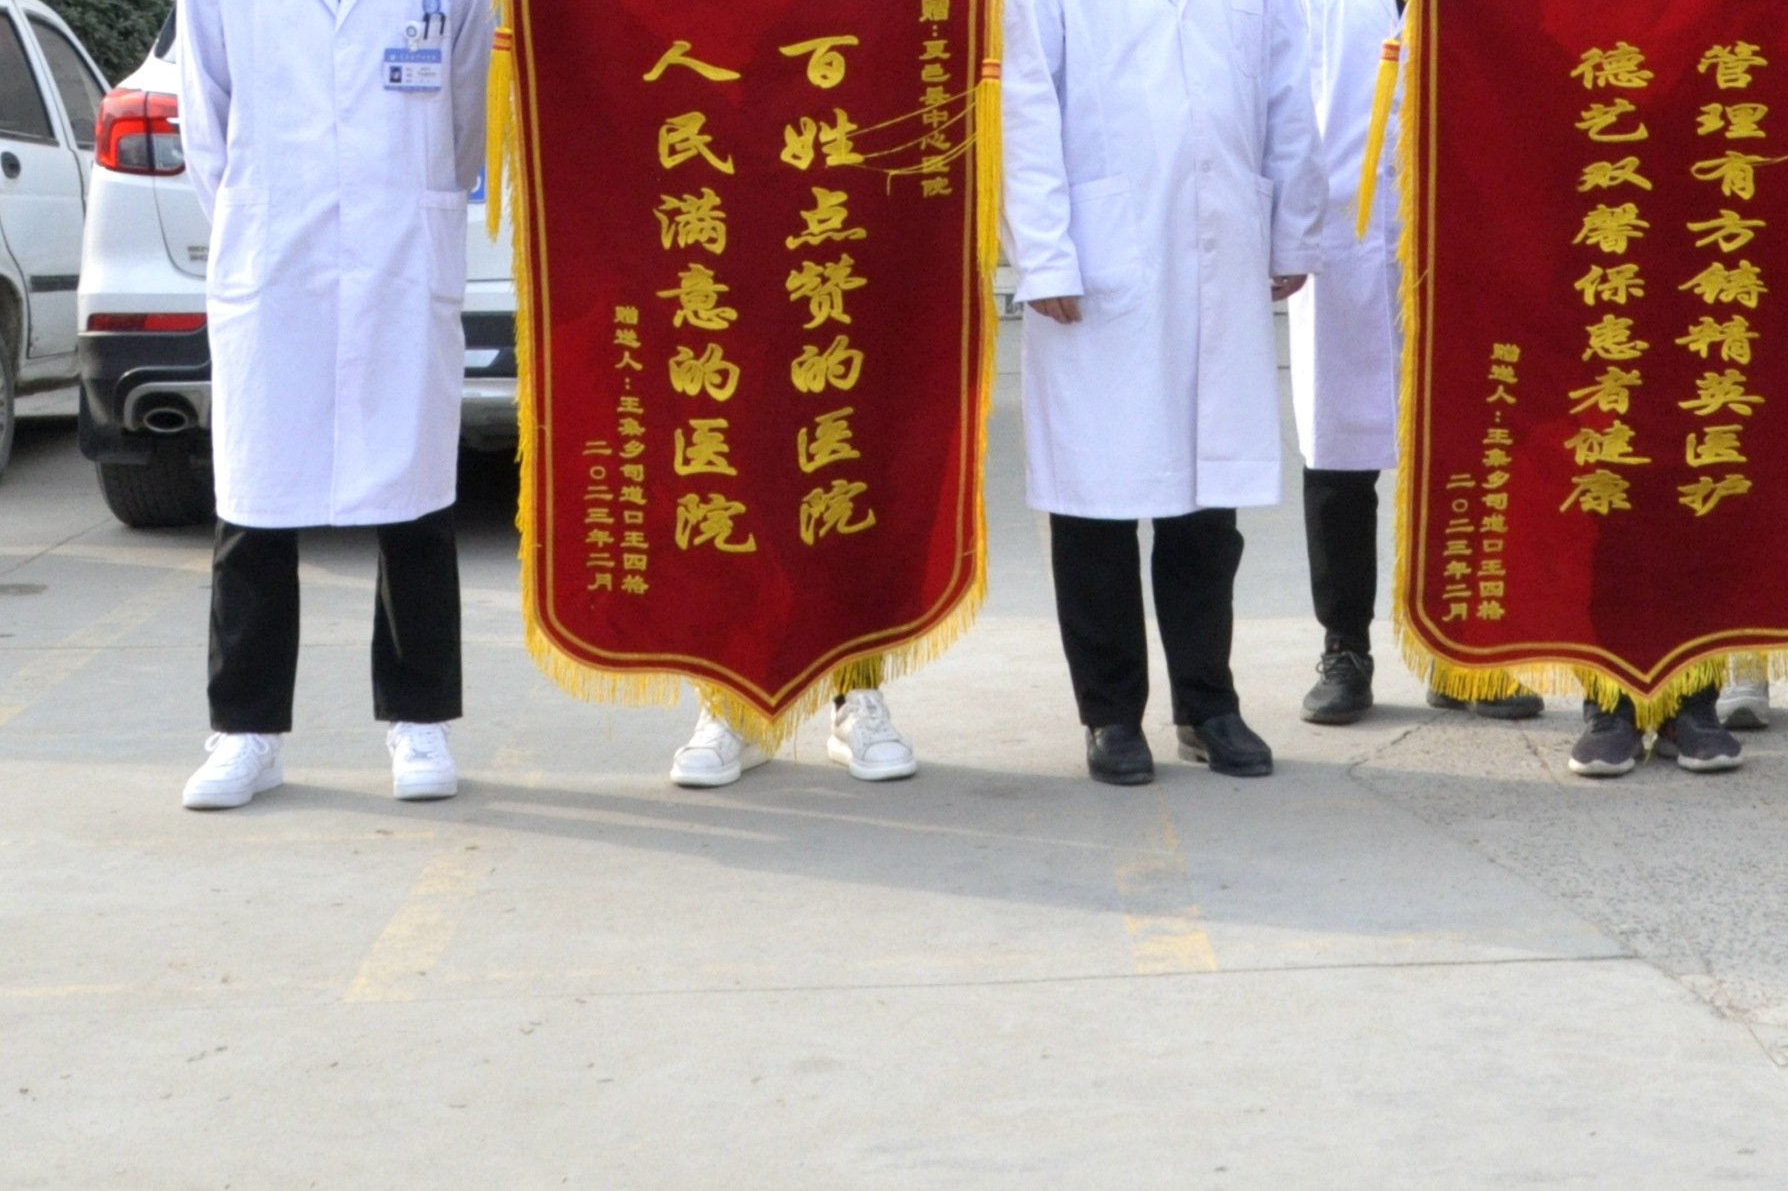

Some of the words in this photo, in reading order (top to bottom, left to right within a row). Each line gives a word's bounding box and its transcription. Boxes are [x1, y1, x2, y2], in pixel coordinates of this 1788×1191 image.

[643, 41, 757, 553] 人民满意的医院
[779, 35, 876, 546] 百姓点赞的医院
[1559, 41, 1654, 516] 德艺双馨保患者健康
